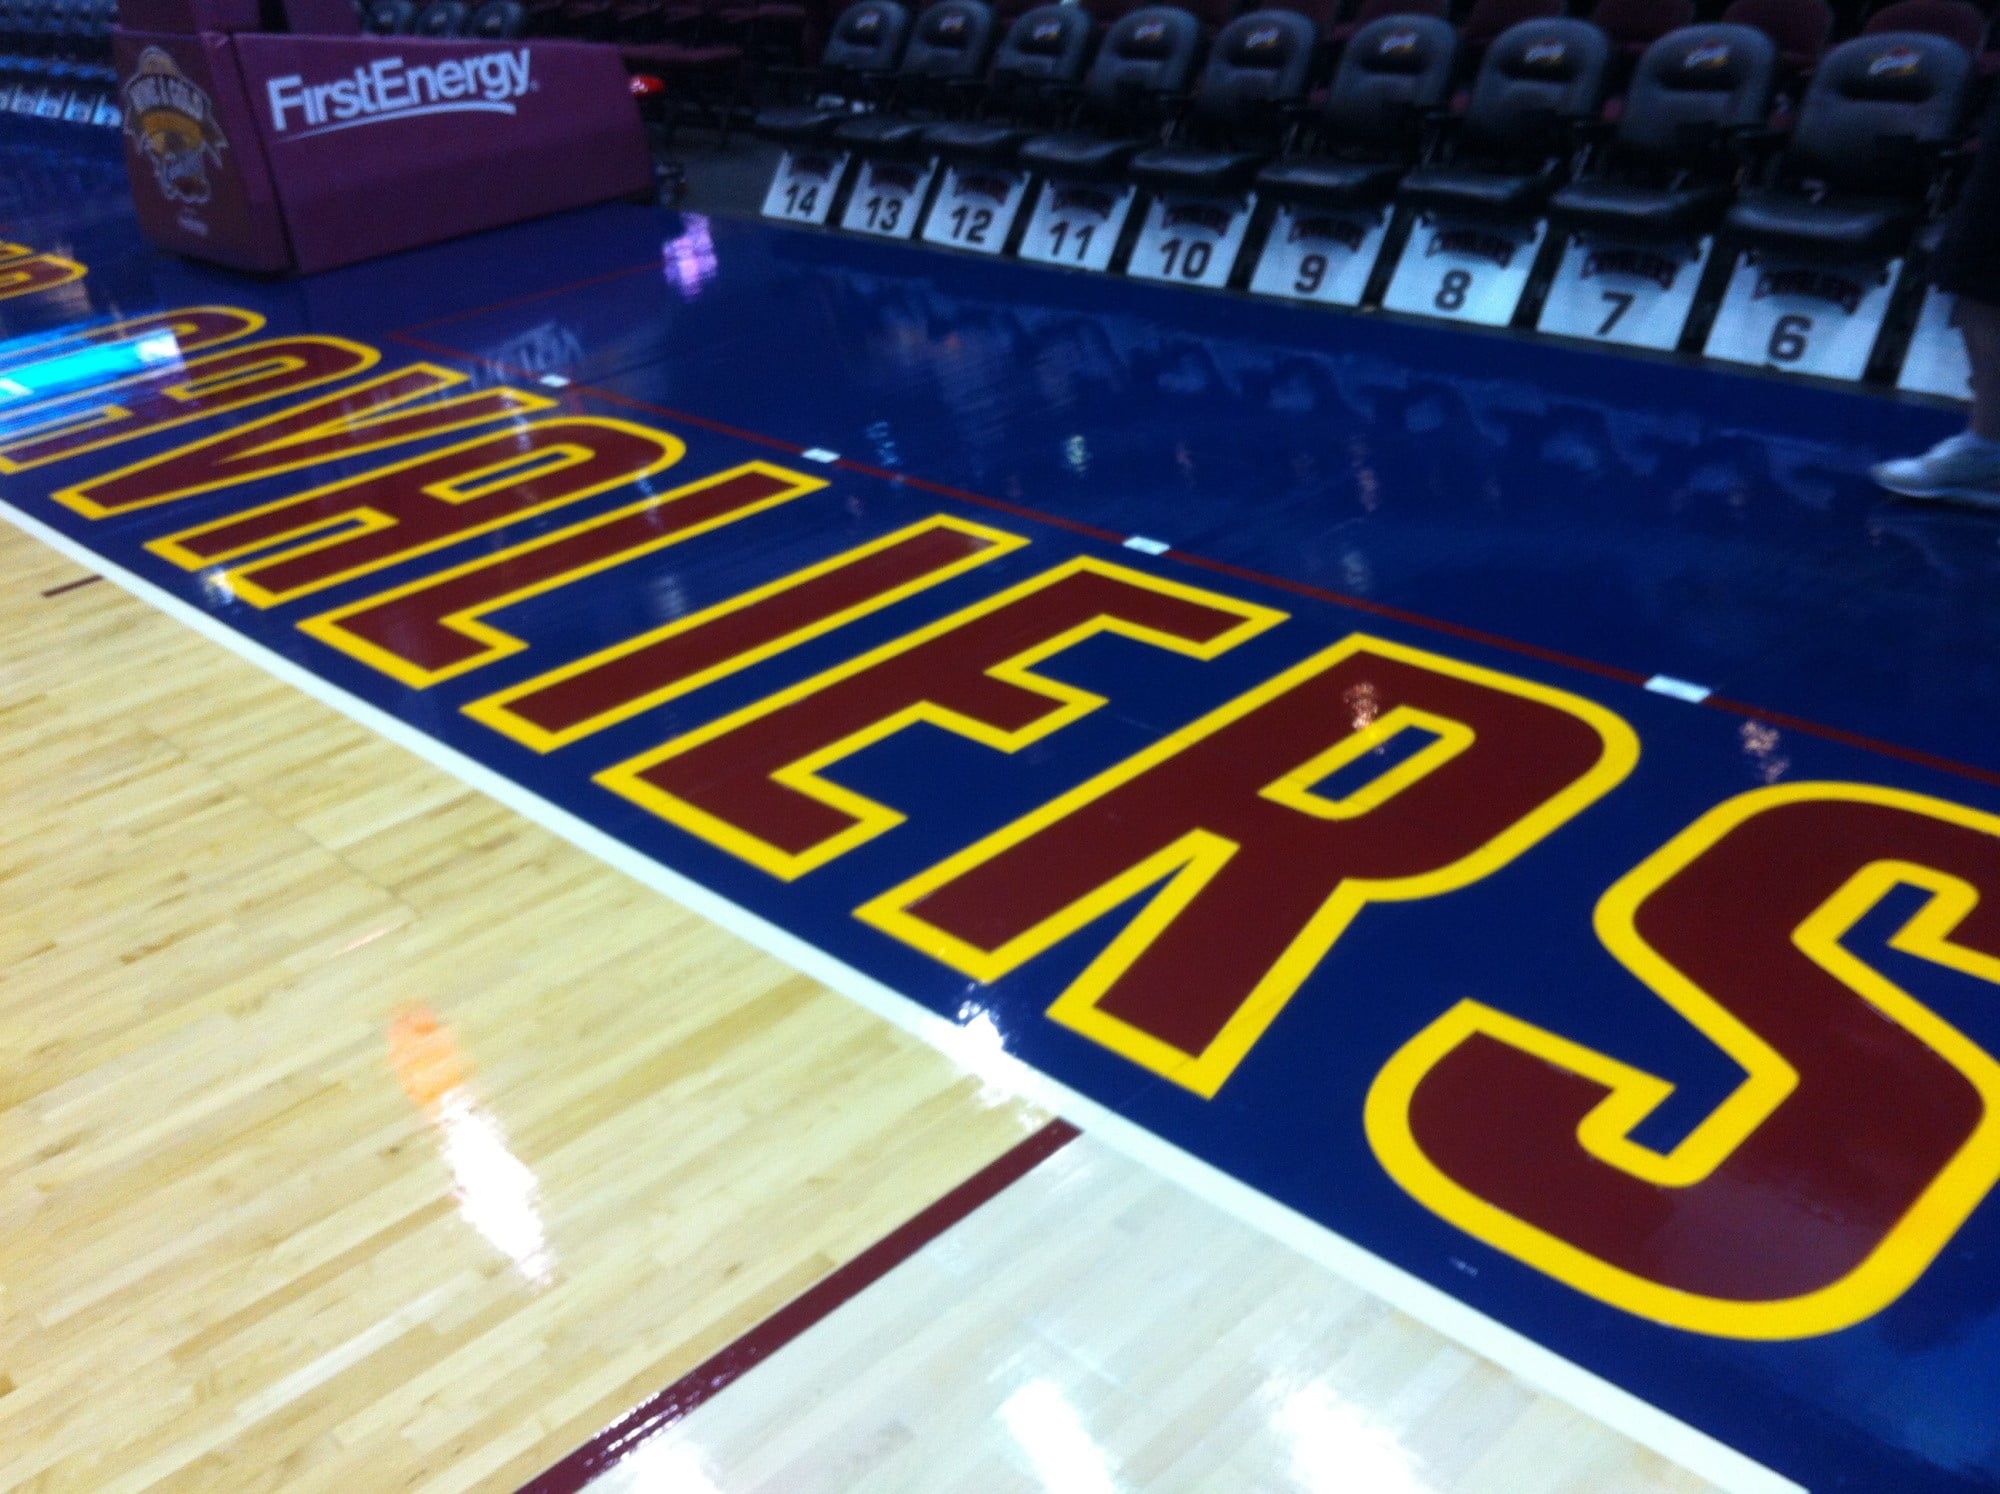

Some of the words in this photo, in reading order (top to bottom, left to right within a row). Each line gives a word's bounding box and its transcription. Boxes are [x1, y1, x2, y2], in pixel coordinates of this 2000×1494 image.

[266, 47, 531, 131] FirstEnergy
[783, 184, 819, 216] 14
[866, 196, 904, 231] 13
[950, 205, 991, 243] 12
[1049, 222, 1094, 260] 11
[1160, 238, 1212, 278] 10
[1294, 254, 1328, 293] 9
[1434, 270, 1472, 311] 8
[1597, 292, 1635, 335] 7
[1768, 315, 1812, 362] 6
